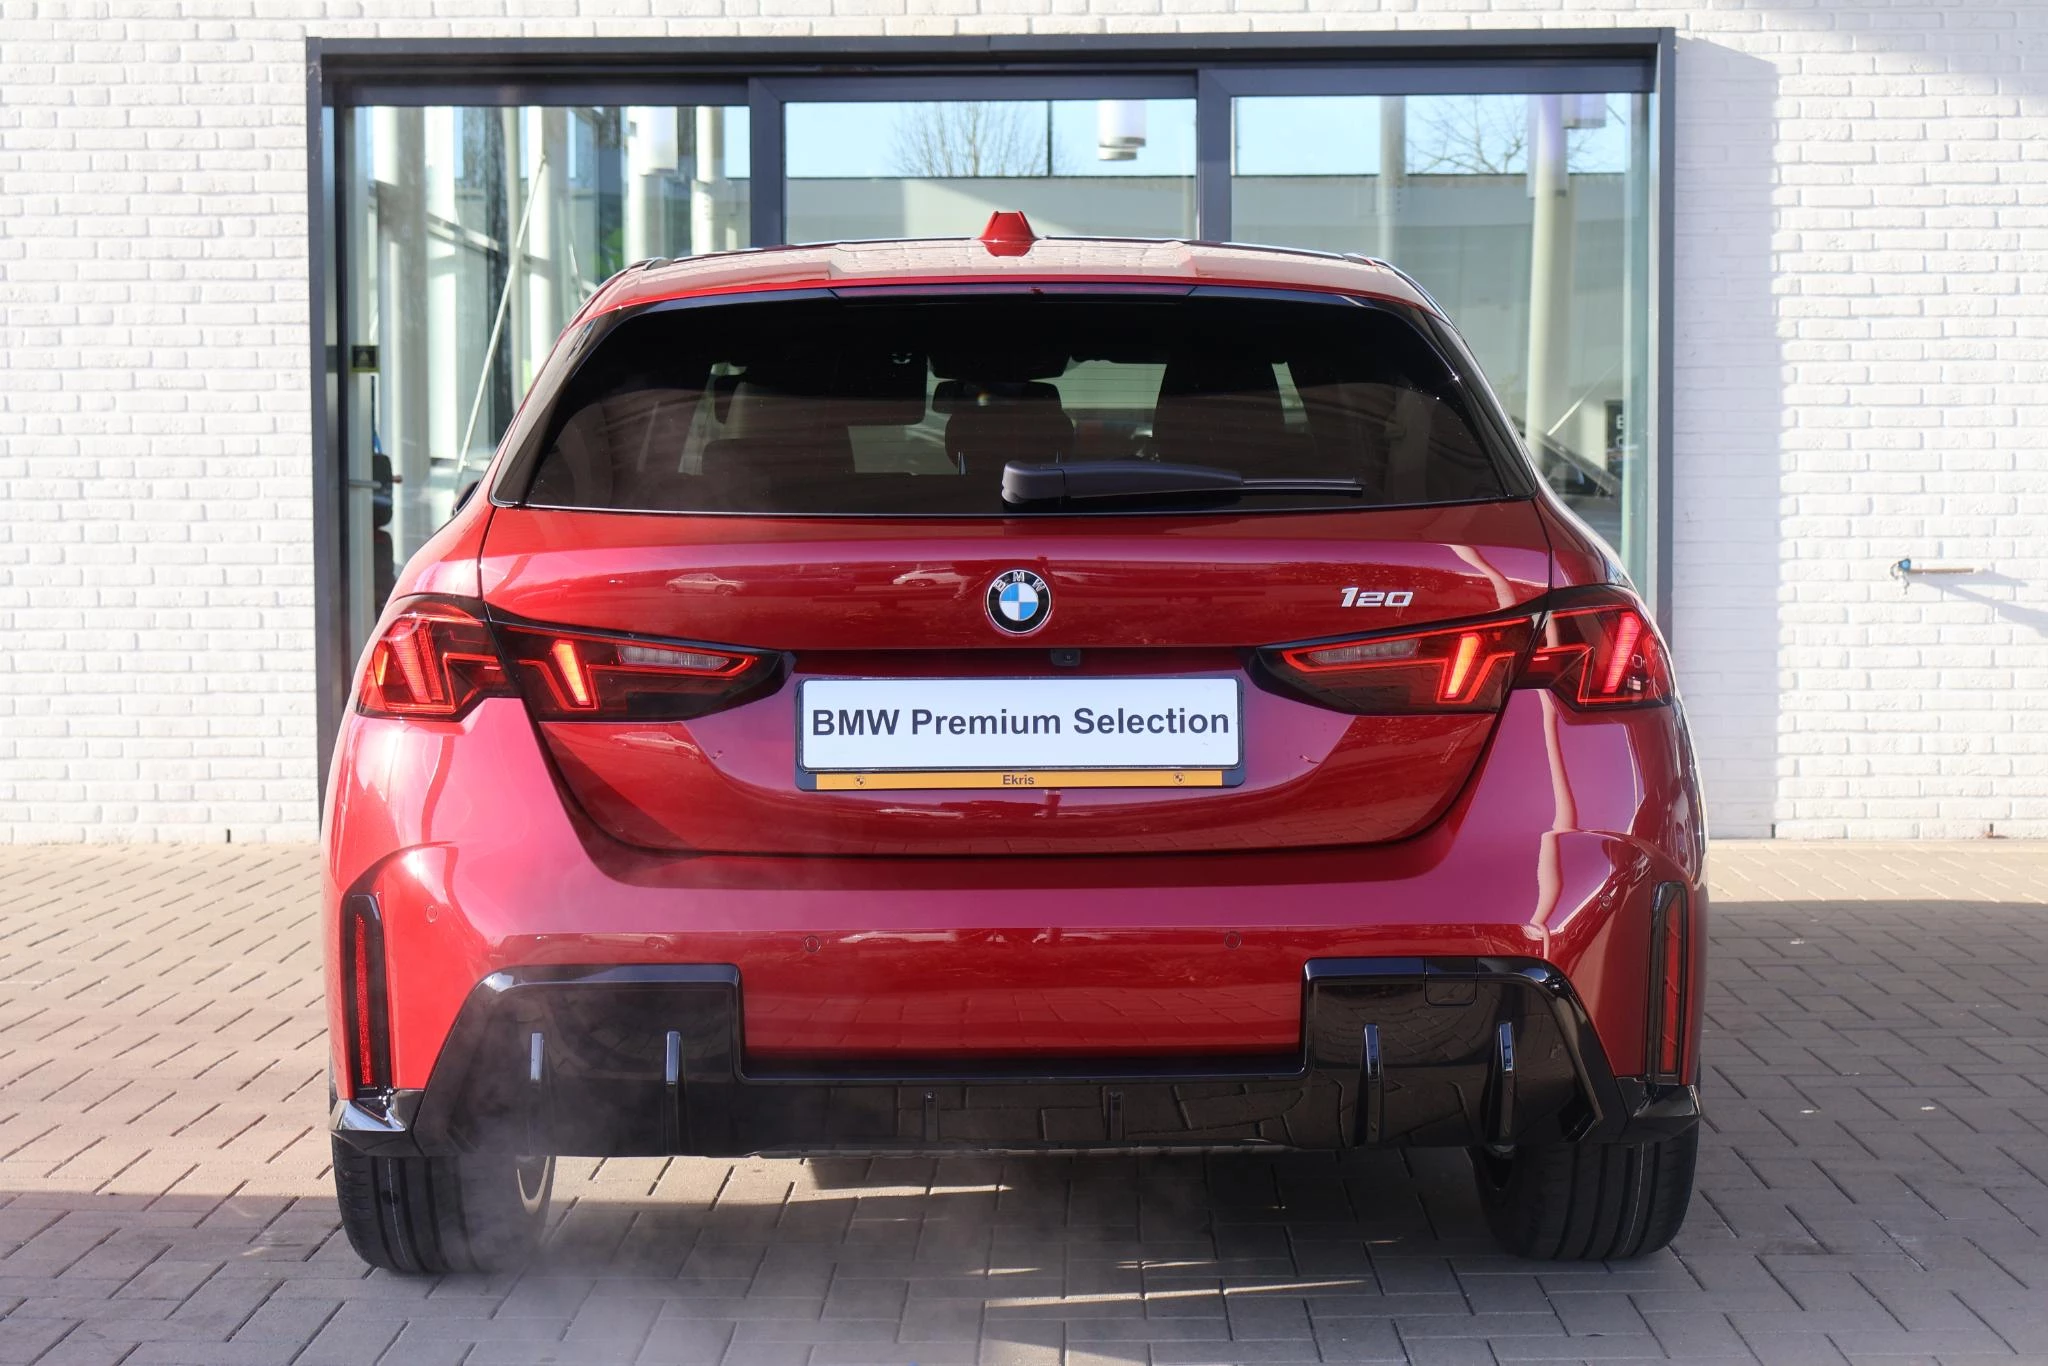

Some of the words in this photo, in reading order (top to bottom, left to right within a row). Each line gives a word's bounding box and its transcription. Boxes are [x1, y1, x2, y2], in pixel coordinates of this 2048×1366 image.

[994, 571, 1045, 592] BMW
[1341, 587, 1414, 607] 120
[813, 709, 900, 735] BMW
[912, 709, 1061, 735] Premium
[1073, 707, 1229, 734] Selection
[1002, 774, 1035, 785] Ekris
